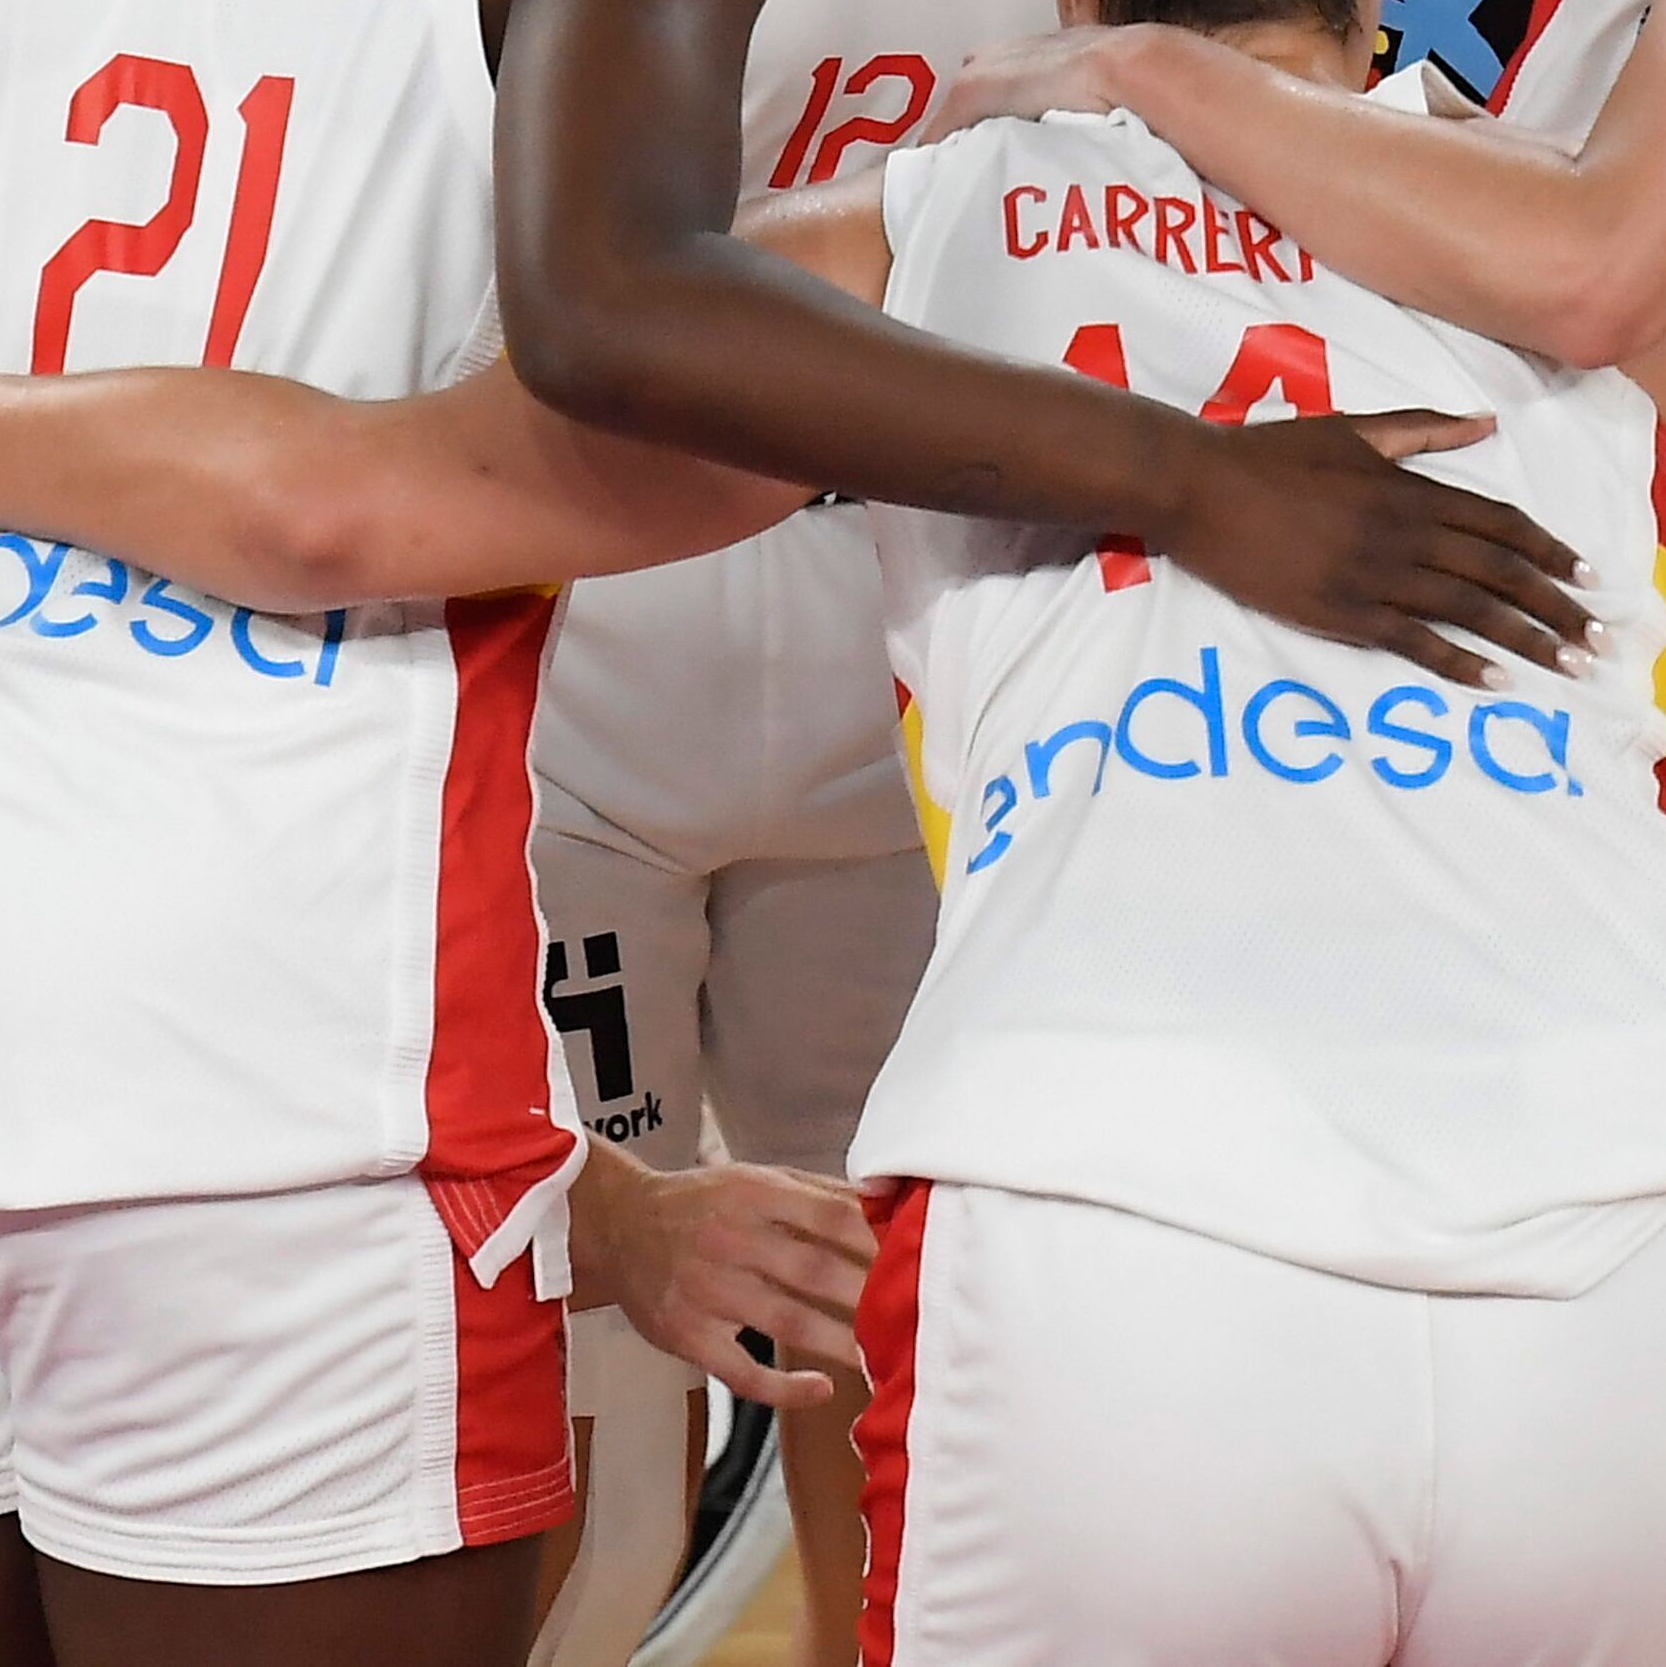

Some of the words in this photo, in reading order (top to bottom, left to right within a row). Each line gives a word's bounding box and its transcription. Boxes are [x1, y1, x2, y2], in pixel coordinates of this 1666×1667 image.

[33, 52, 298, 375] 21
[768, 53, 937, 188] 12
[965, 646, 1585, 876] endesa
